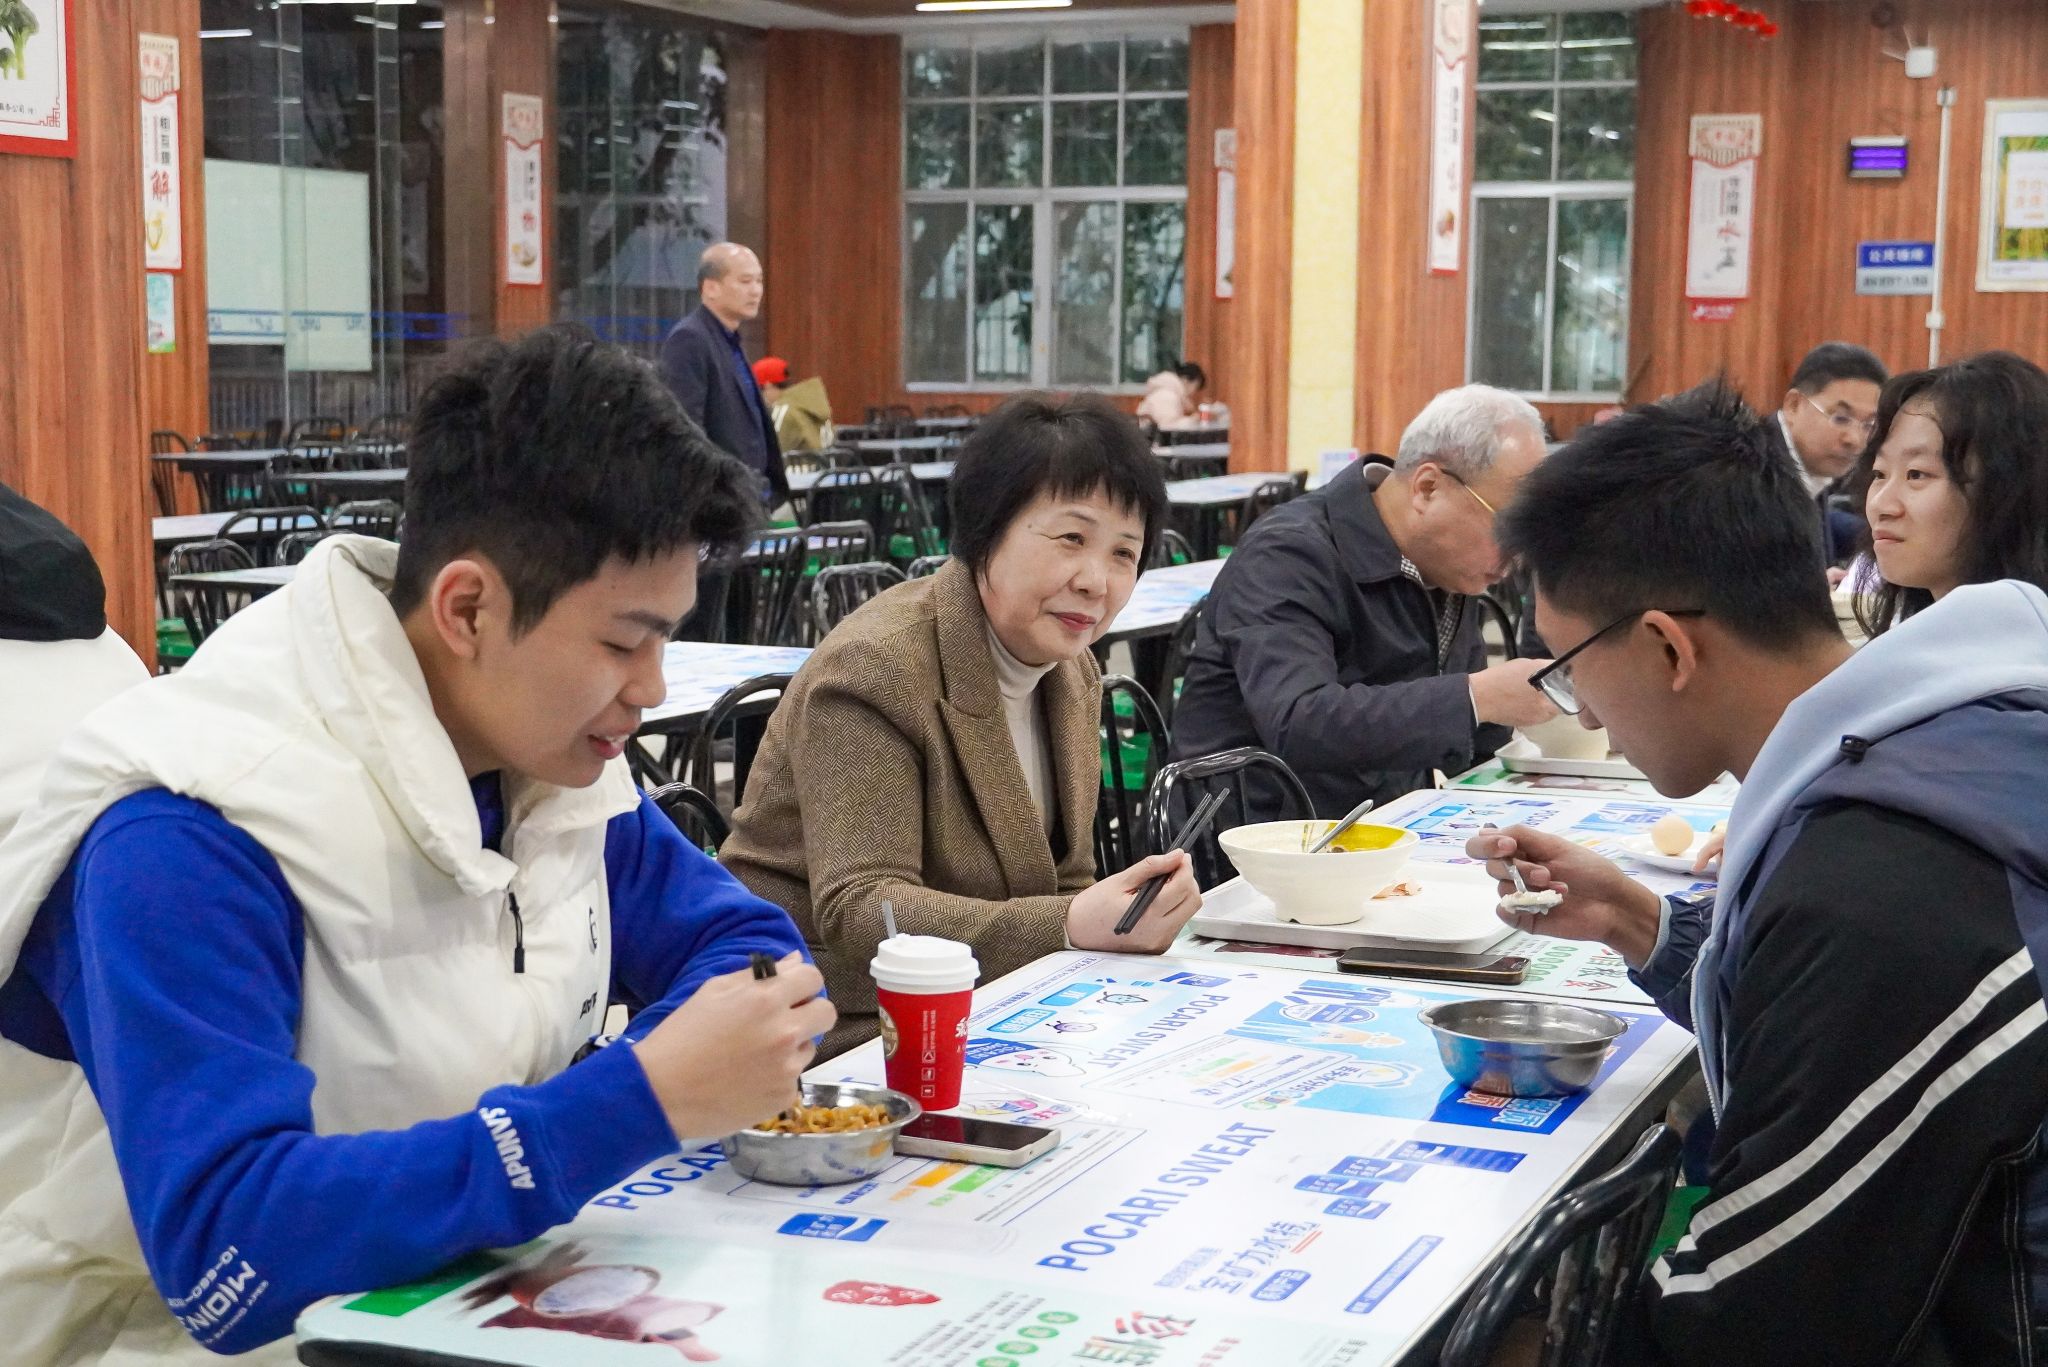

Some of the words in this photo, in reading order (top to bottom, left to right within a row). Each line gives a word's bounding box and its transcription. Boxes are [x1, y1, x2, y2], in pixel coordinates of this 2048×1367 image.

[1148, 994, 1230, 1031] POCARI
[1088, 1031, 1167, 1068] SWEAT
[1036, 1188, 1189, 1271] POCARI
[1158, 1122, 1276, 1187] SWEAT
